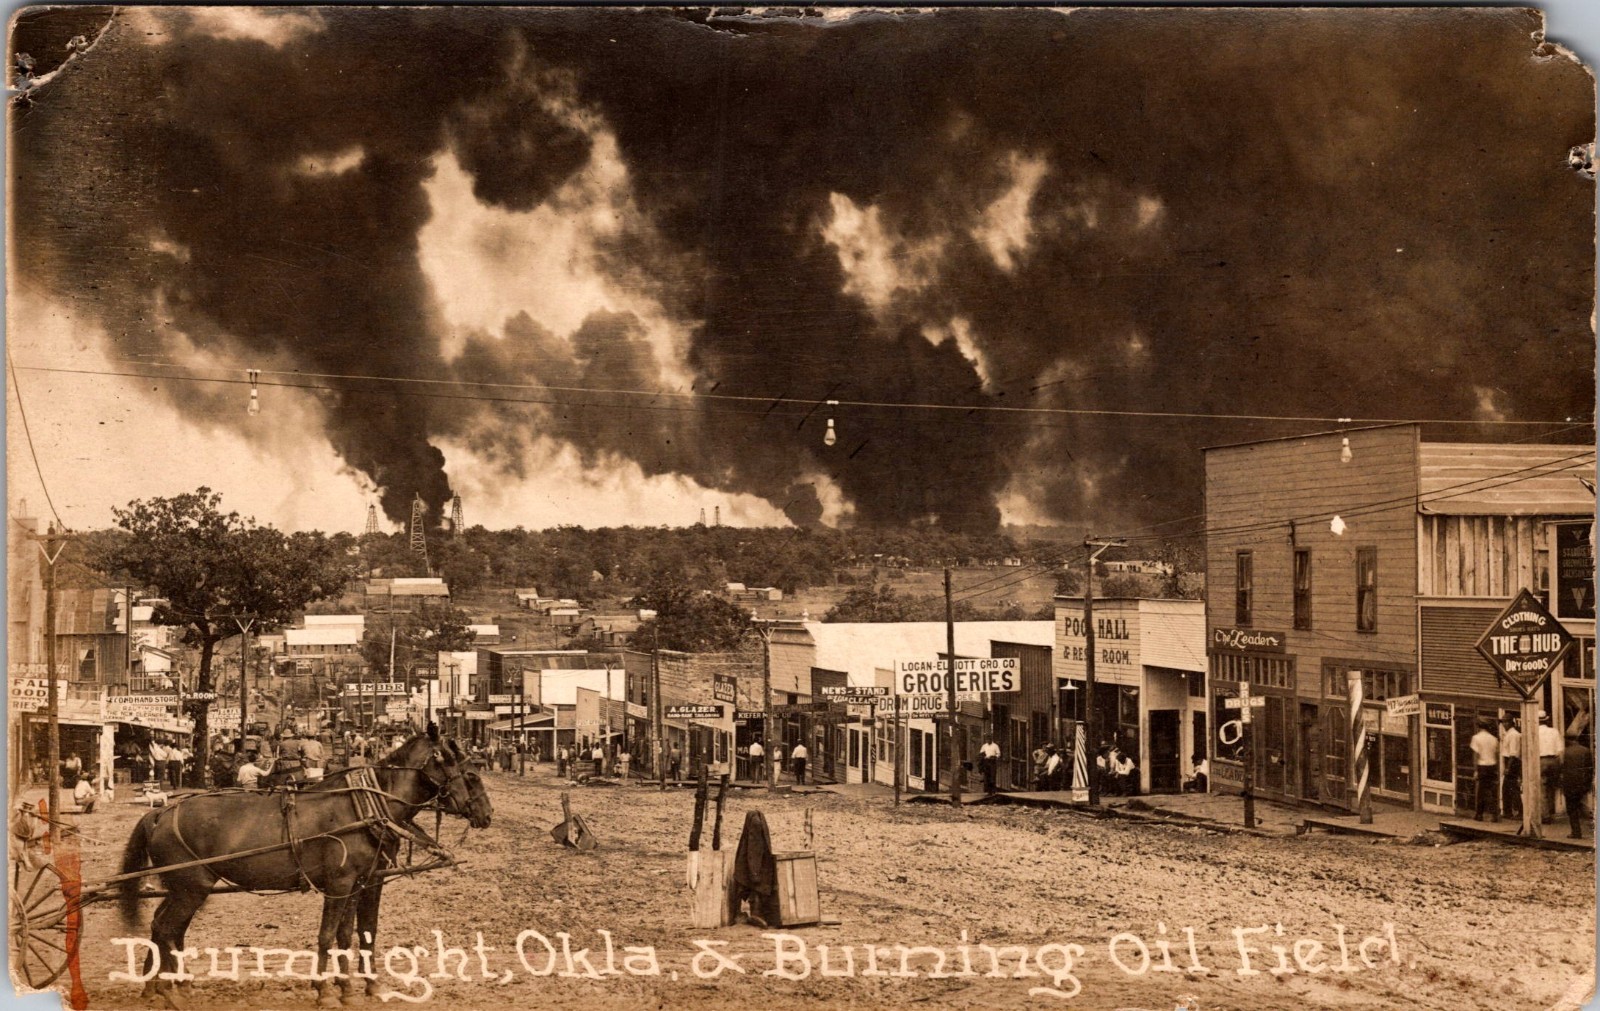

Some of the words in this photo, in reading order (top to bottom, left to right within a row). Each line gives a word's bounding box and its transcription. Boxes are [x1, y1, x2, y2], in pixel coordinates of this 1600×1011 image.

[1502, 611, 1547, 629] CLOTHING
[1064, 617, 1087, 637] POO
[1098, 618, 1130, 640] HALL
[1215, 629, 1230, 645] The
[1490, 635, 1518, 655] THE
[1532, 633, 1562, 653] HUB
[1063, 645, 1071, 660] &
[1072, 646, 1088, 661] RES
[1102, 648, 1132, 665] ROOM.
[901, 660, 976, 672] LOGAN-ELIOTT
[1505, 658, 1522, 672] DRY
[1522, 657, 1549, 671] GOODS
[821, 686, 847, 695] NEWS
[855, 687, 886, 695] STAND
[879, 696, 908, 712] DRM
[912, 696, 942, 711] DRUG
[1225, 697, 1265, 708] DRUGS
[1239, 681, 1251, 724] DRUGS
